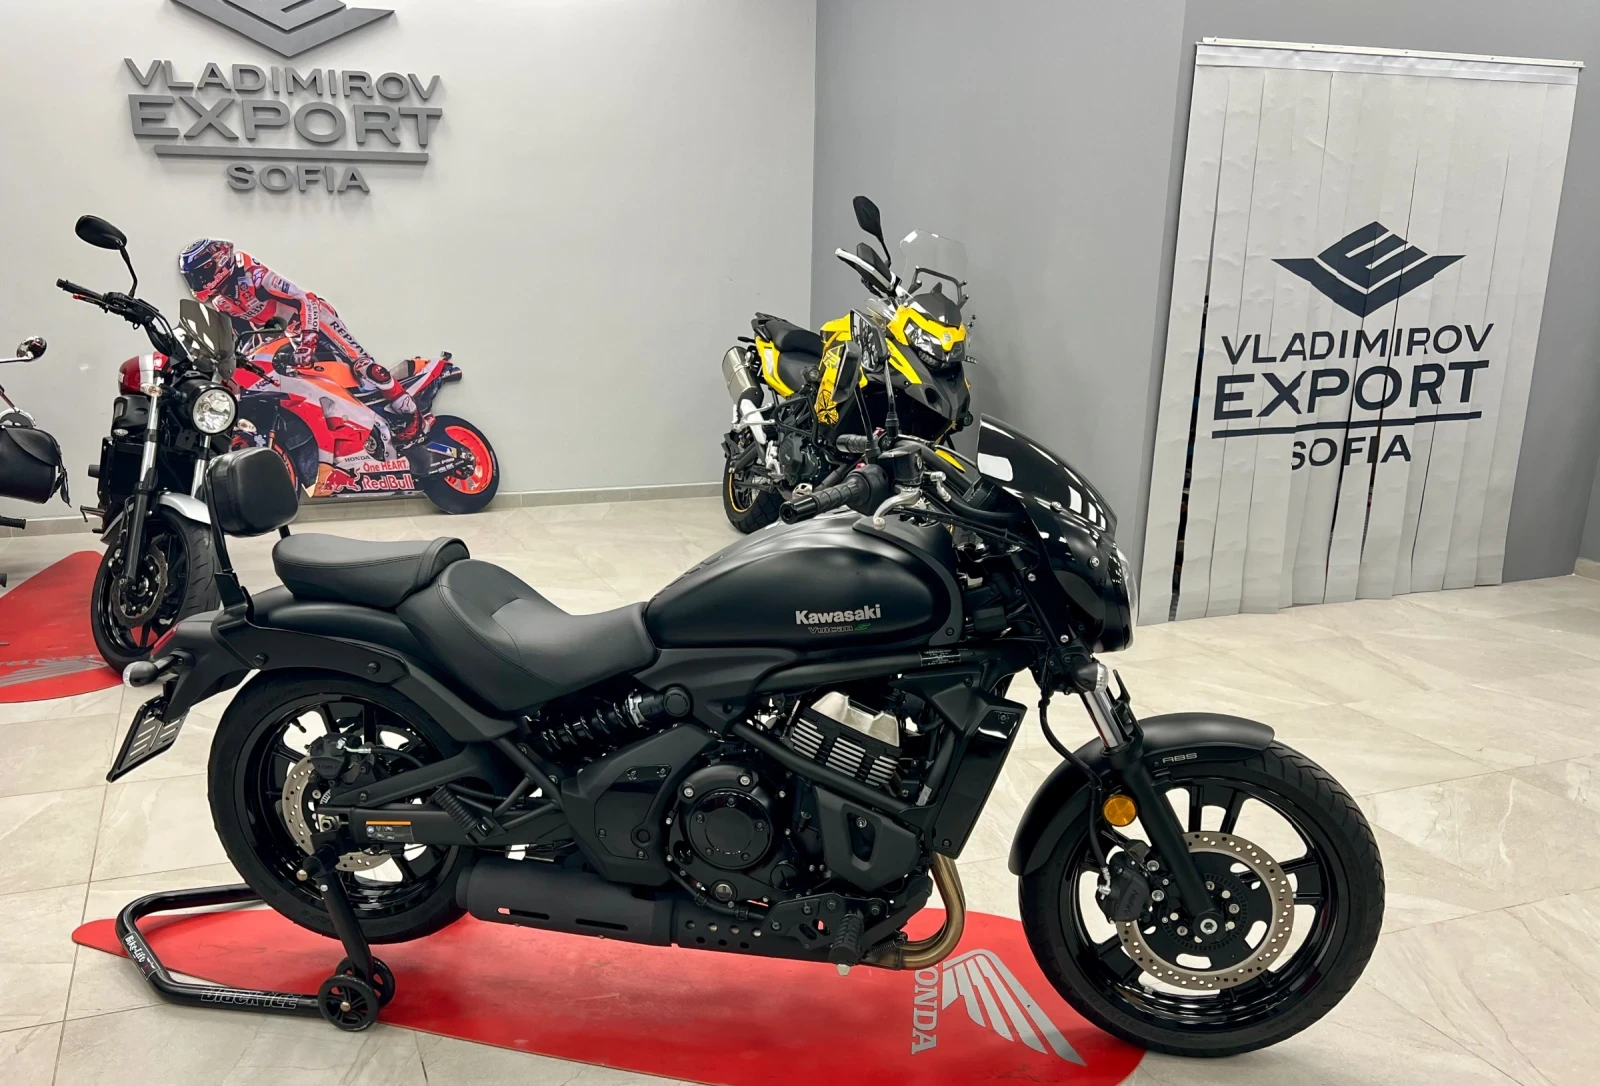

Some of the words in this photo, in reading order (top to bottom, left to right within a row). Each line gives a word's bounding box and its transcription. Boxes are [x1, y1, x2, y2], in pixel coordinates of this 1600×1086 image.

[124, 58, 440, 100] VLADIMIROV
[128, 94, 443, 146] EXPORT
[227, 163, 370, 193] SOFIA
[1221, 323, 1494, 365] VLADIMIROV
[1213, 360, 1490, 421] EXPORT
[344, 455, 371, 463] HONDA
[363, 463, 379, 472] One
[1291, 434, 1411, 470] SOFIA
[795, 603, 882, 625] Kawasaki
[1162, 752, 1198, 764] ABS
[911, 964, 940, 1055] ONDA
